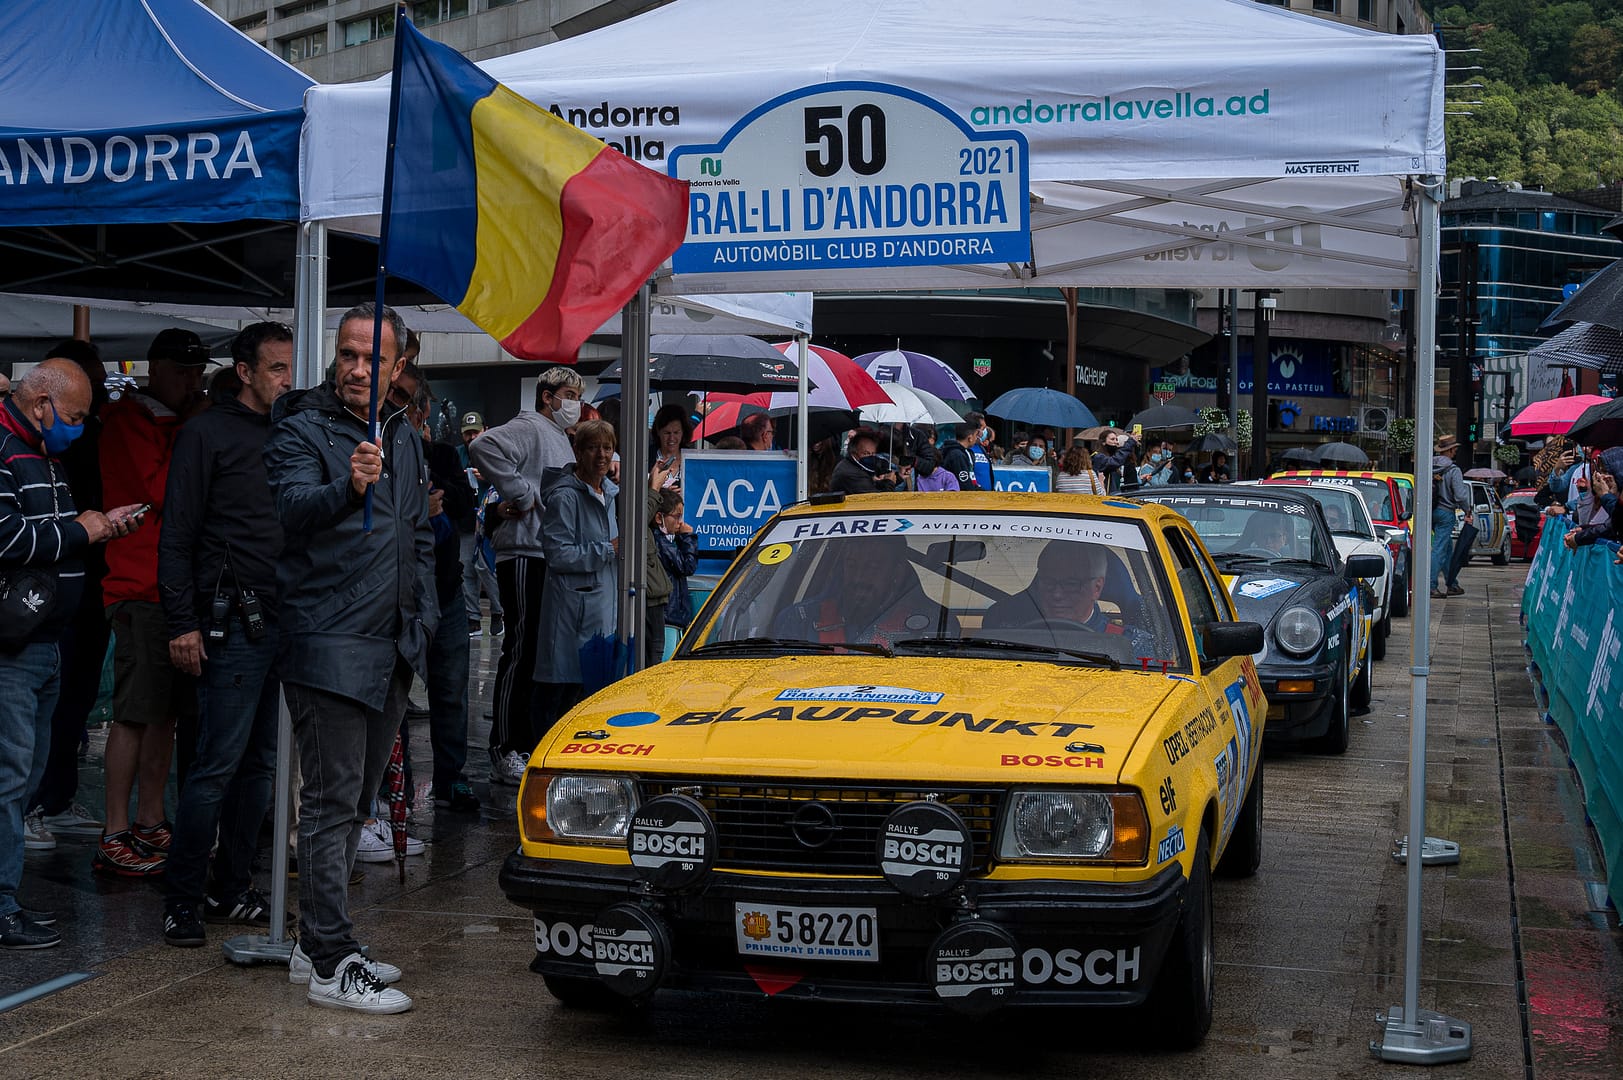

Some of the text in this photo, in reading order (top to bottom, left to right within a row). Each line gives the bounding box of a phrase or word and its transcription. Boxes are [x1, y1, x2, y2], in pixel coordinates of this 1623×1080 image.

[549, 101, 680, 128] Andorra
[970, 88, 1270, 126] andorralavella.ad
[804, 103, 887, 177] 50
[959, 146, 1014, 175] 2021
[713, 238, 994, 264] AUTOMÒBIL CLUB D'ANDORRA
[1285, 383, 1325, 393] PASTEUR
[696, 479, 782, 519] ACA
[1214, 498, 1279, 510] TEAM
[794, 518, 1114, 540] FLARE AVIATION CONSULTING
[770, 549, 781, 559] 2
[665, 705, 1096, 739] BLAUPUNKT
[560, 743, 656, 756] BOSCH
[1163, 731, 1190, 766] OPEL
[1001, 754, 1104, 769] BOSCH
[1159, 775, 1177, 816] elf
[635, 817, 664, 827] RALLYE
[888, 824, 919, 835] RALLYE
[633, 832, 705, 856] BOSCH
[884, 839, 962, 866] BOSCH
[1158, 831, 1184, 864] NECTO
[681, 862, 694, 871] 180
[936, 871, 950, 881] 180
[593, 926, 617, 936] RALLYE
[776, 910, 873, 947] 58220
[594, 941, 654, 963] BOSCH
[745, 943, 872, 957] PRINCIPAT D'ANDORRA
[938, 949, 970, 958] RALLYE
[636, 970, 647, 978] 180
[936, 961, 1015, 983] BOSCH
[991, 988, 1004, 996] 180
